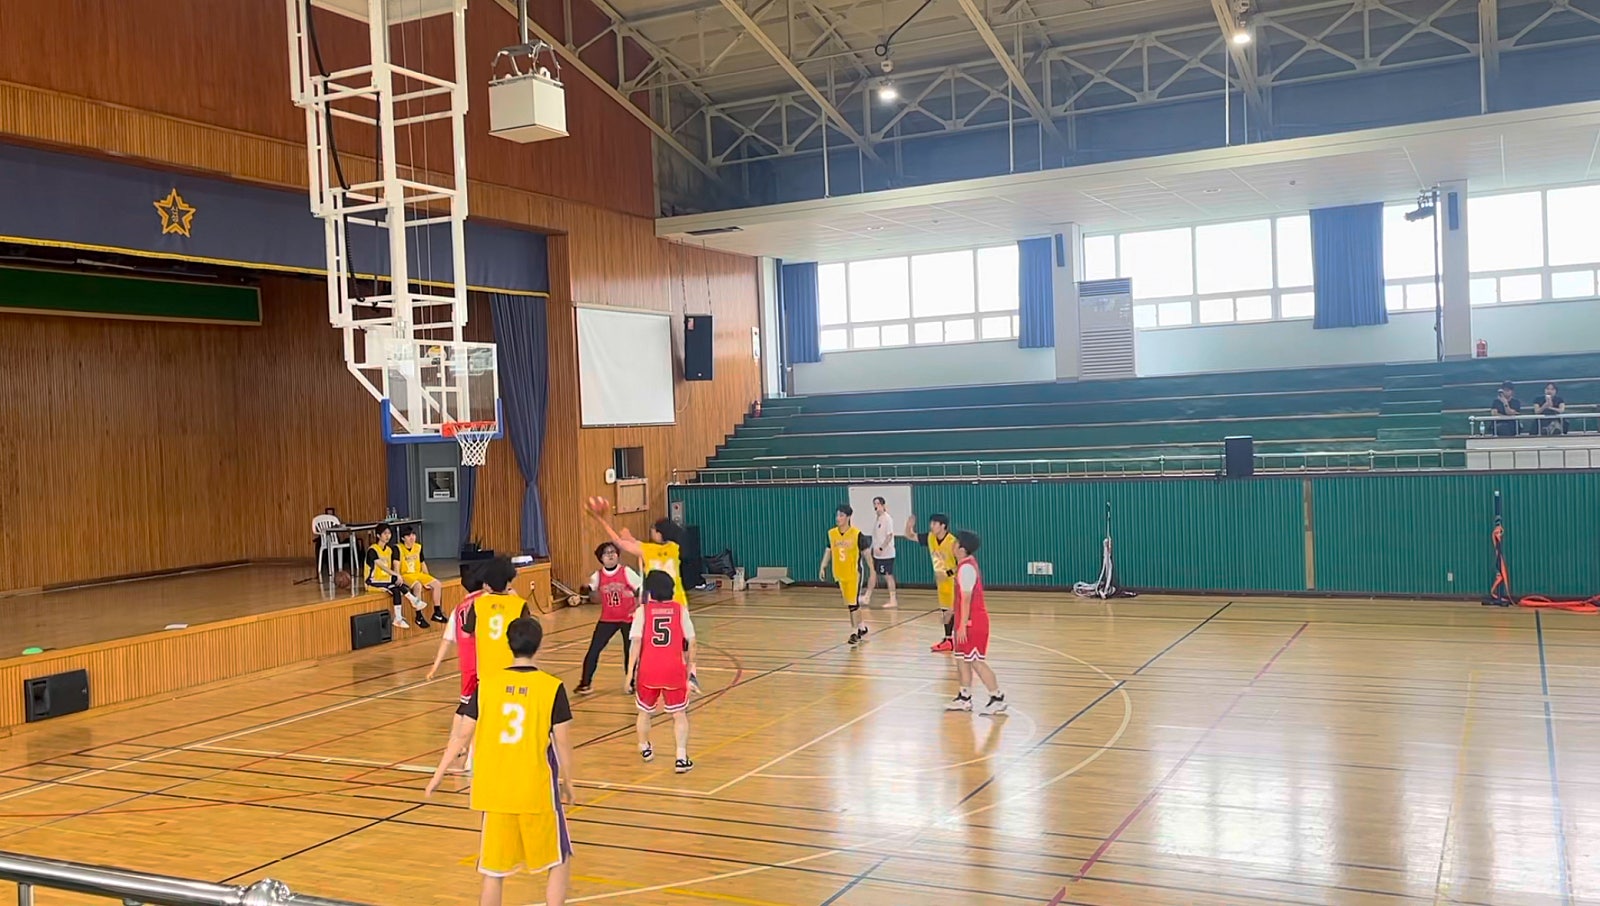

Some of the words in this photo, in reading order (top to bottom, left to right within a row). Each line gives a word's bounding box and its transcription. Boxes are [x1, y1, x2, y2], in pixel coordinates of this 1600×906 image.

[606, 590, 621, 607] 14
[489, 614, 504, 640] 9
[651, 616, 671, 647] 5
[500, 702, 526, 744] 3
